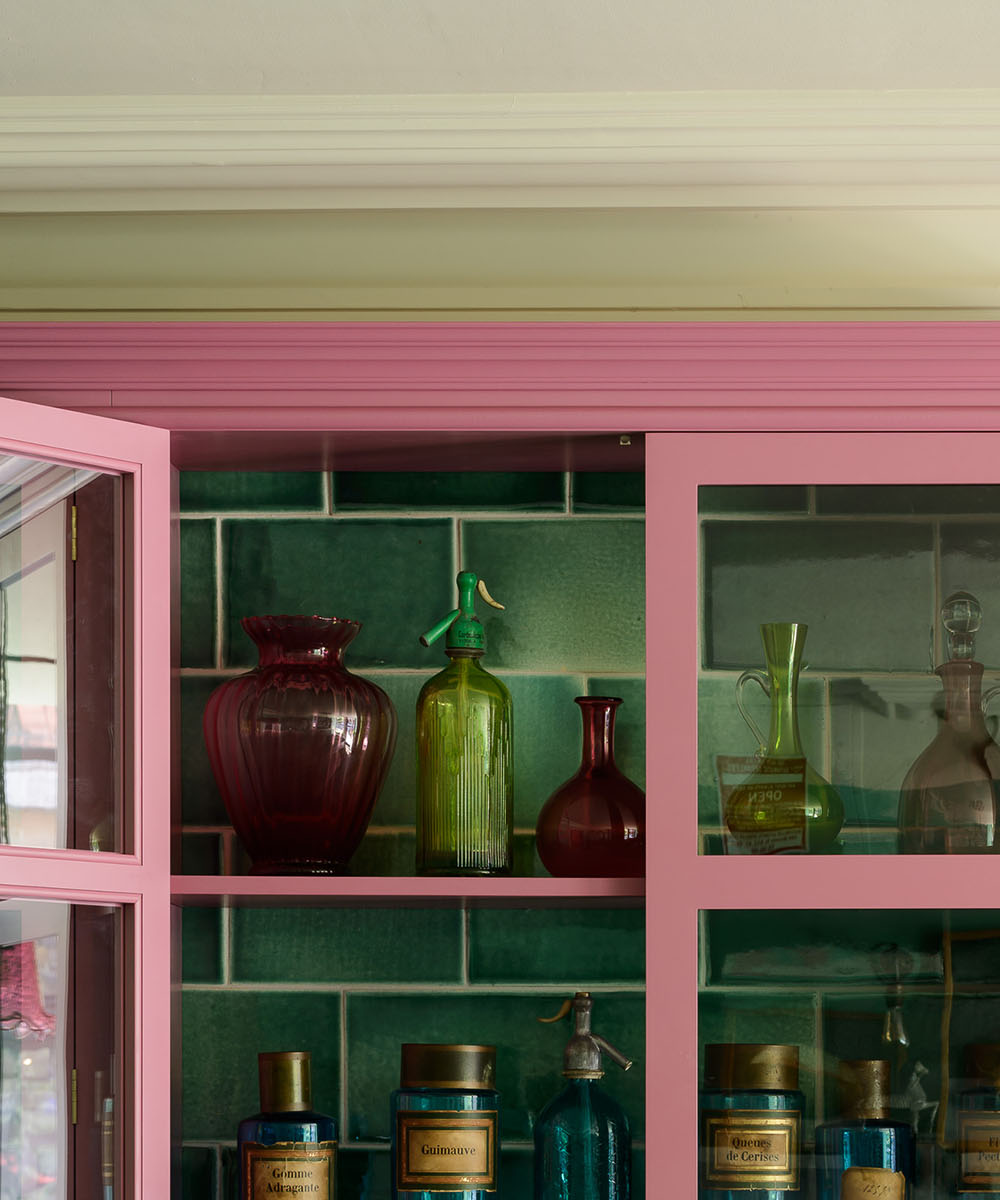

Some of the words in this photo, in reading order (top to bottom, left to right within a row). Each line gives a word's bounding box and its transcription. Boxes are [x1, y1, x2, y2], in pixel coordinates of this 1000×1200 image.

[732, 1137, 771, 1149] Queues
[421, 1144, 476, 1155] Guimauve
[726, 1151, 739, 1161] de
[741, 1151, 779, 1162] Cerises
[272, 1168, 313, 1179] Gomme
[265, 1182, 320, 1195] Adragante
